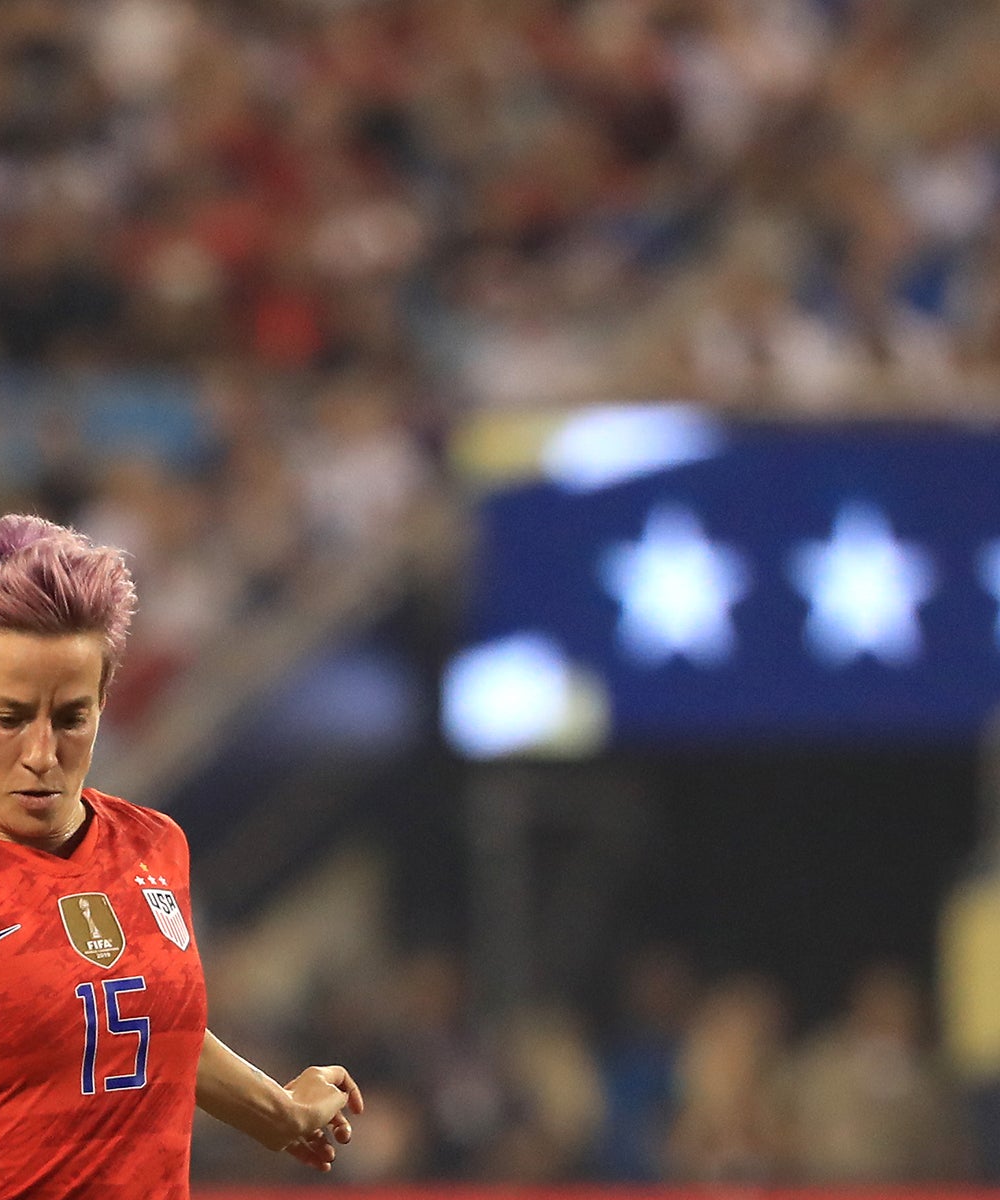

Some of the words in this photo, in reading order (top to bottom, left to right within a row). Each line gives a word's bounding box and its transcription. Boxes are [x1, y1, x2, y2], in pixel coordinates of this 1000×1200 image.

[146, 892, 176, 915] USA
[86, 938, 113, 951] FIFA
[74, 976, 150, 1095] 15
